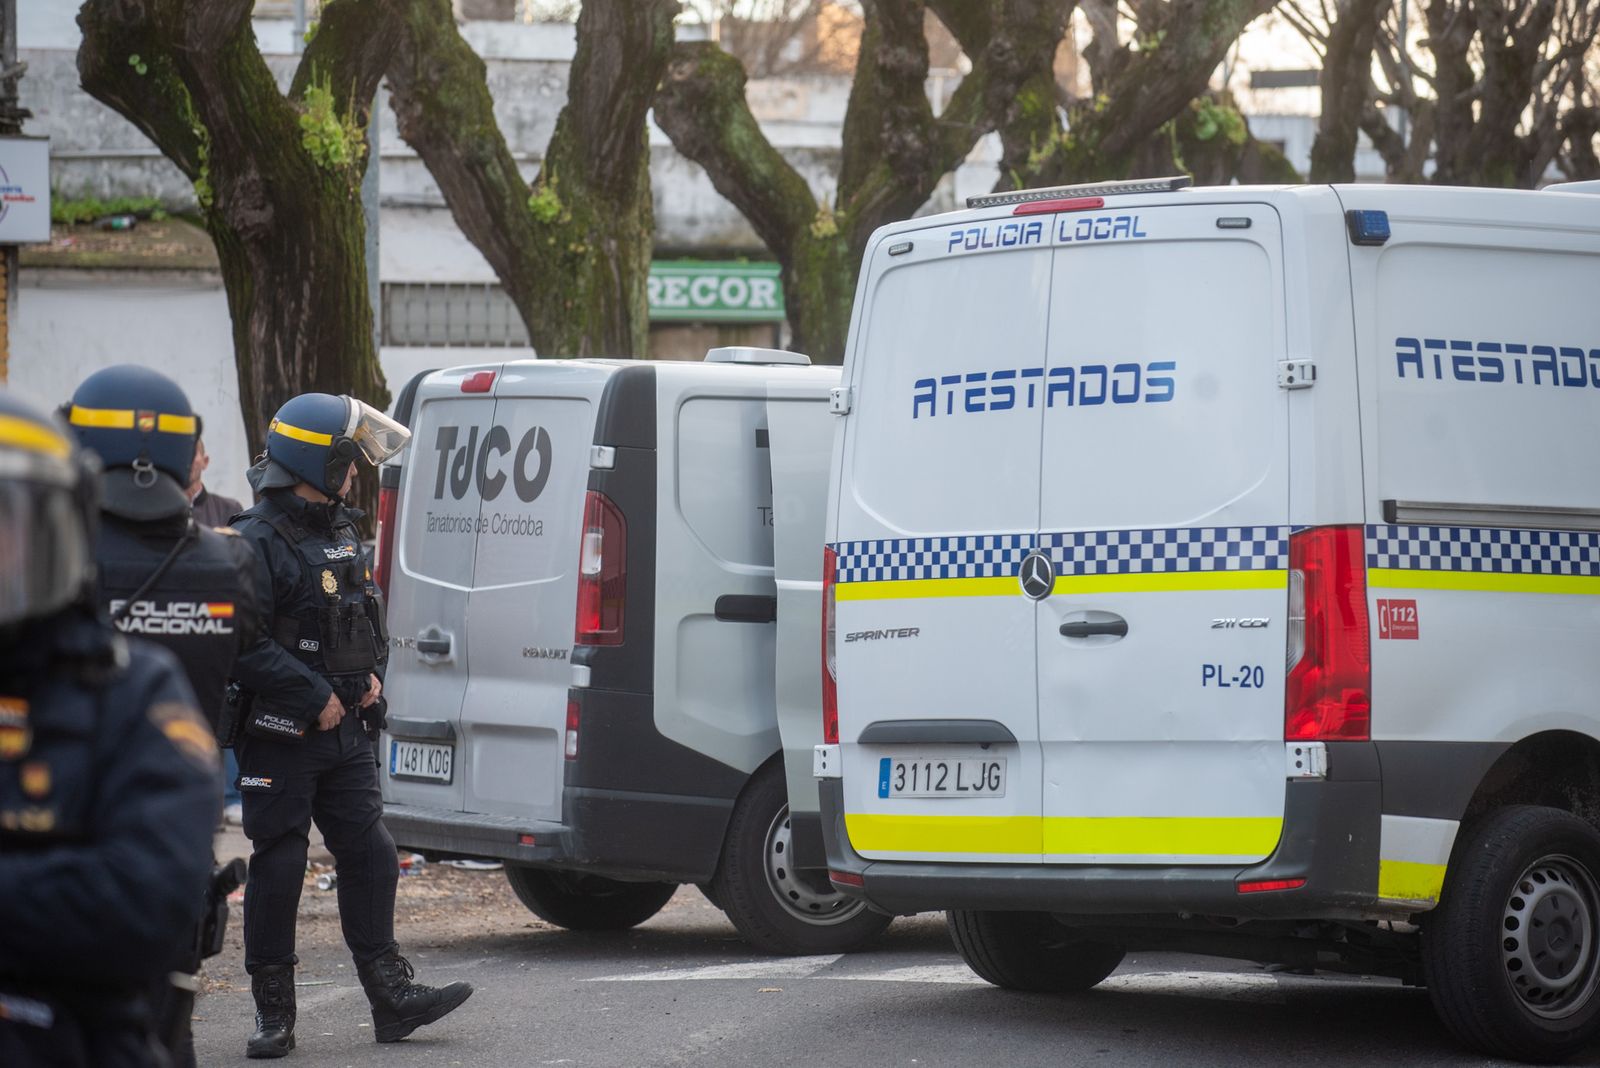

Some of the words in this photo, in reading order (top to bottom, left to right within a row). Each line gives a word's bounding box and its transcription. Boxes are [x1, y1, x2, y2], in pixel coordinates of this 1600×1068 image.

[948, 221, 1043, 253] POLICIA
[1058, 215, 1147, 242] LOCAL
[912, 361, 1176, 419] ATESTADOS
[426, 511, 472, 534] Tanatorios
[474, 513, 489, 534] de
[491, 512, 543, 537] Córdoba
[109, 600, 211, 618] POLICIA
[1391, 606, 1416, 622] 112
[1211, 618, 1236, 629] 211
[844, 627, 920, 643] SPRINTER
[1202, 664, 1264, 689] PL-20
[255, 719, 301, 735] NACIONAL
[263, 714, 294, 727] POLICIA
[400, 746, 424, 773] 1481
[427, 748, 450, 775] KDG
[894, 762, 948, 792] 3112
[956, 762, 1001, 792] LJG
